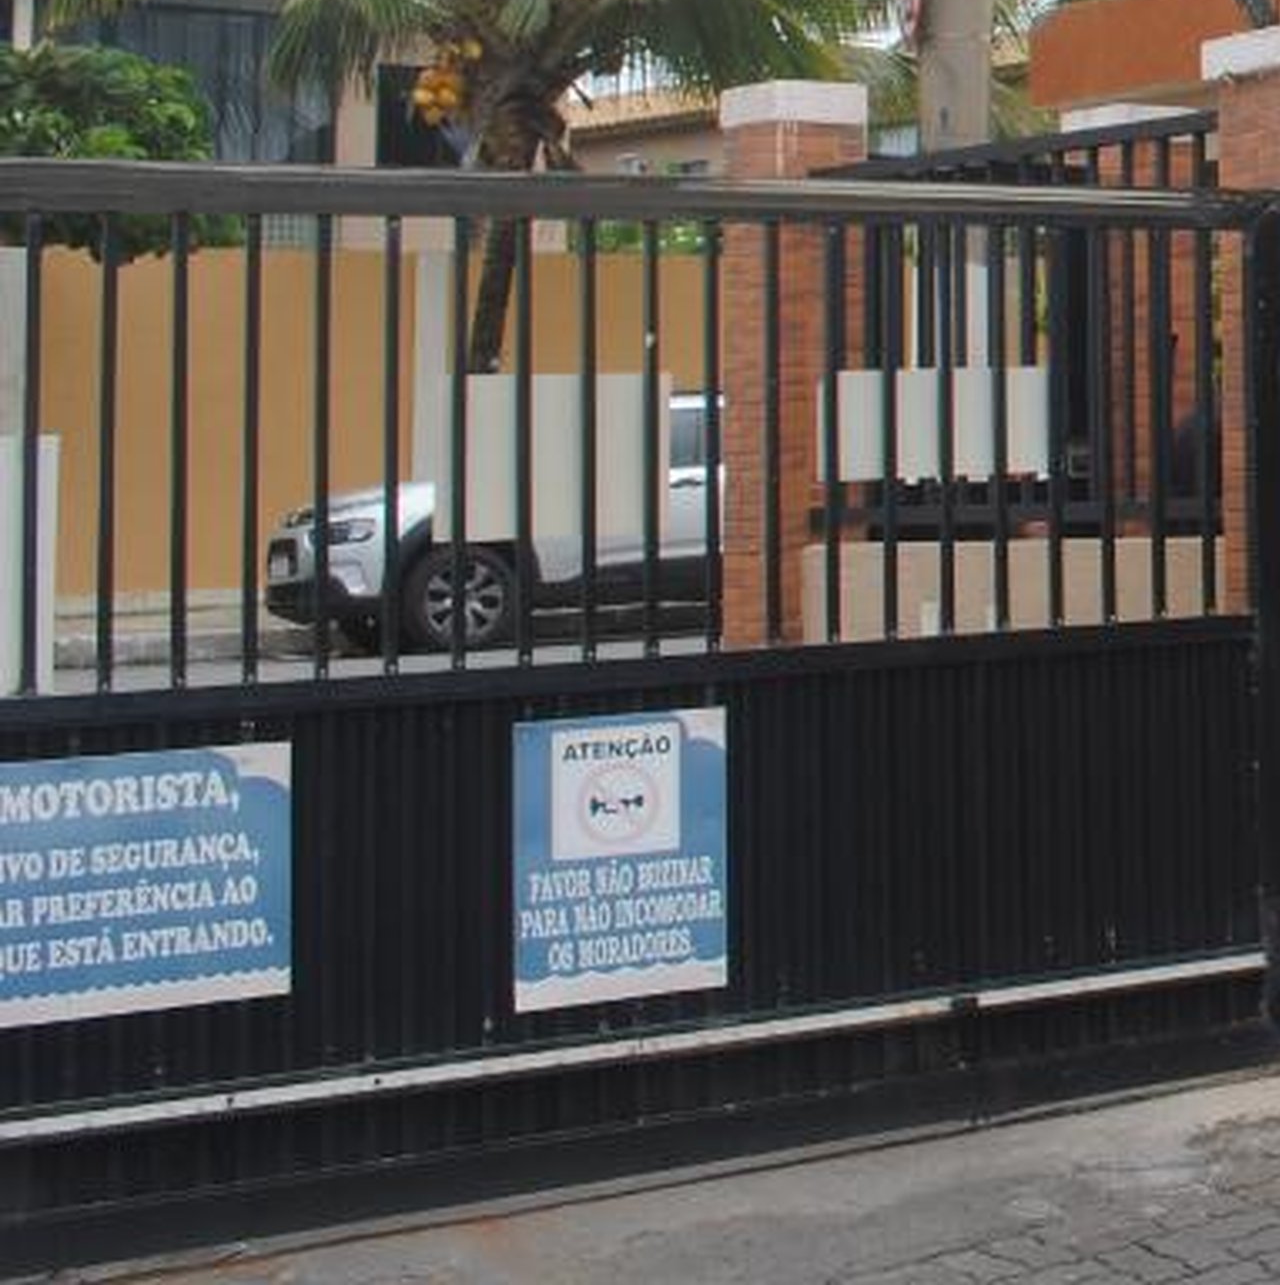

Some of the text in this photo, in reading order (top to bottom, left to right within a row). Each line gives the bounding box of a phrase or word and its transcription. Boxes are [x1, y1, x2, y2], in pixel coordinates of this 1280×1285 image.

[563, 736, 671, 762] ATENÇÃO
[0, 770, 239, 823] MOTORISTA,
[50, 847, 85, 878] DE
[91, 833, 259, 872] SEGURANÇA,
[33, 879, 214, 925] PREFERÊNCIA
[222, 875, 258, 905] AO
[529, 869, 591, 903] FAVOR
[595, 860, 634, 895] NÃO
[521, 905, 570, 938] PARA
[574, 896, 611, 933] NÃO
[49, 927, 116, 968] ESTÁ
[123, 918, 274, 961] ENTRANDO.
[549, 942, 575, 970] OS
